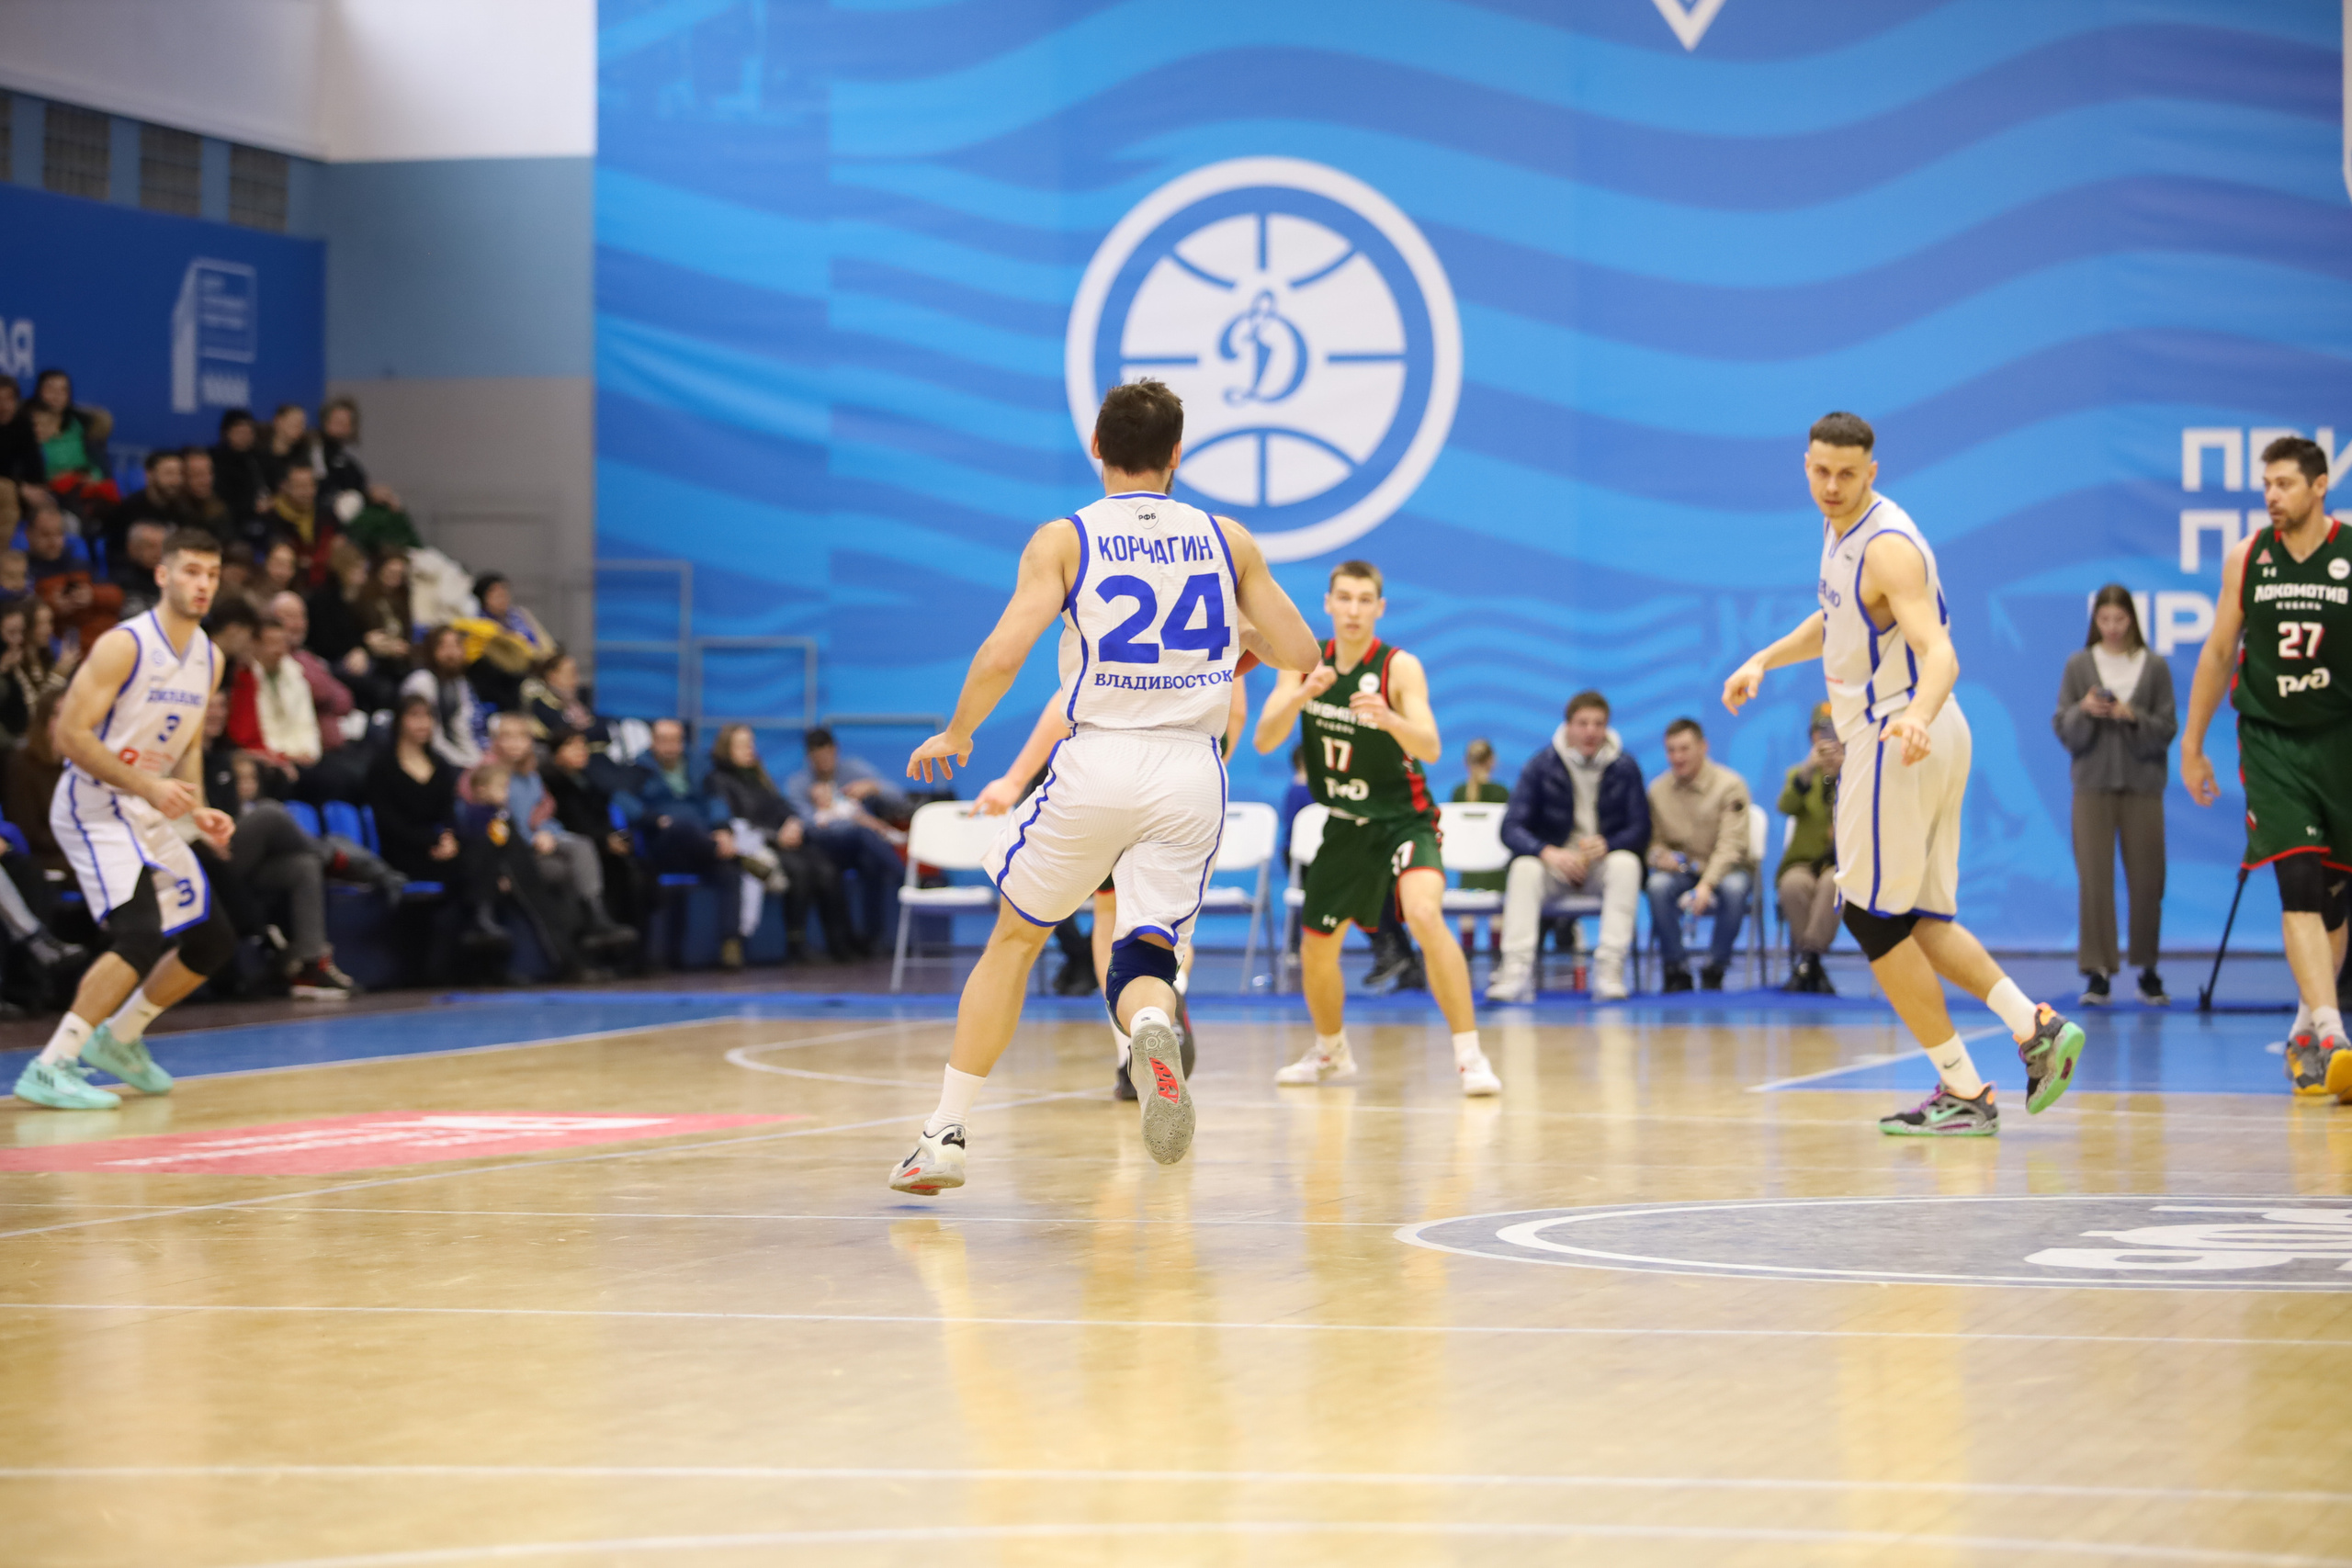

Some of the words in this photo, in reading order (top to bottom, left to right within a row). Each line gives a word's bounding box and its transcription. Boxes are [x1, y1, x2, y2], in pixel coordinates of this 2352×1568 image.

[1098, 535, 1214, 565] КОРЧАГИН
[2254, 583, 2349, 604] ЛОКОМОТИВ
[1095, 572, 1231, 664] 24
[2278, 621, 2325, 660] 27
[1094, 669, 1233, 691] ВЛАДИВОСТОК
[1321, 736, 1353, 773] 17
[175, 878, 196, 908] 3
